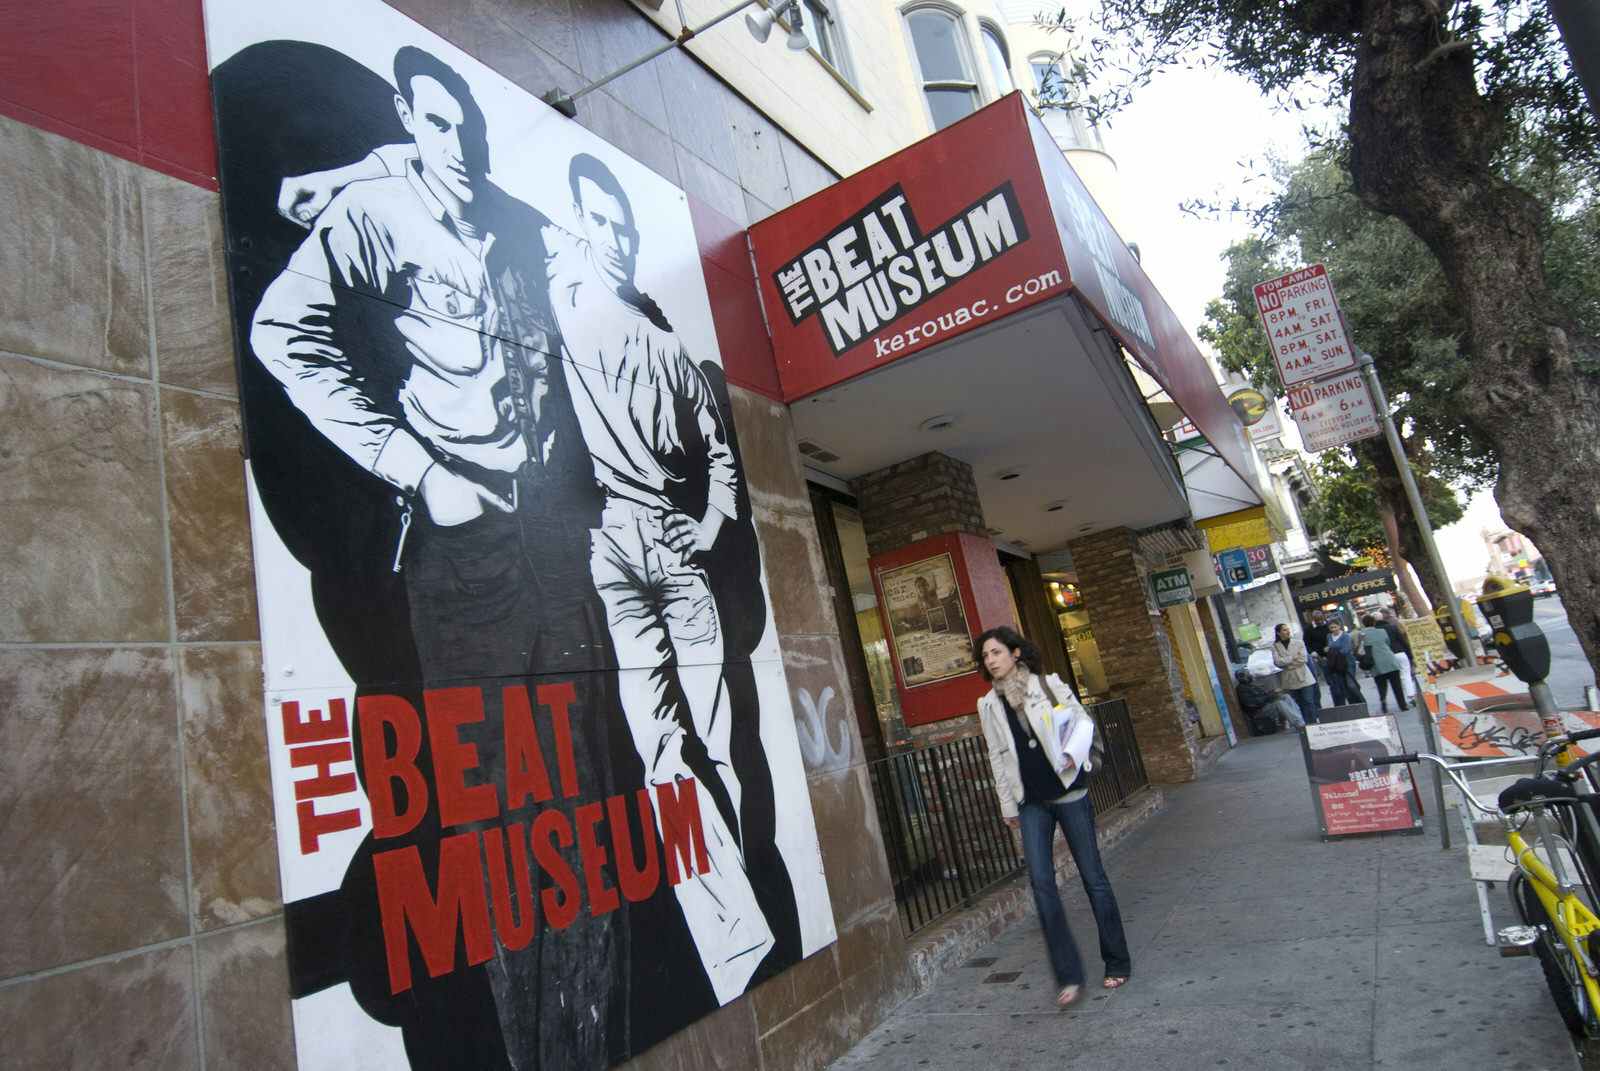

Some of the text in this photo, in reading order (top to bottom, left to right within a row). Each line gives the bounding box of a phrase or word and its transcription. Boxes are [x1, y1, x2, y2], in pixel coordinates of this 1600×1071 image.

[778, 194, 915, 319] THE BEAT
[819, 193, 1018, 352] MUSEUM
[1260, 277, 1326, 311] NO PARKING
[1262, 267, 1317, 292] TOW-AWAY
[1310, 313, 1335, 328] SAT.
[1316, 330, 1341, 345] SAT.
[1290, 376, 1362, 410] NO PARKING
[1156, 573, 1188, 591] ATM
[1329, 586, 1350, 596] LAW
[1351, 578, 1386, 592] OFFICE
[281, 681, 580, 855] THE BEAT
[373, 777, 711, 996] MUSEUM
